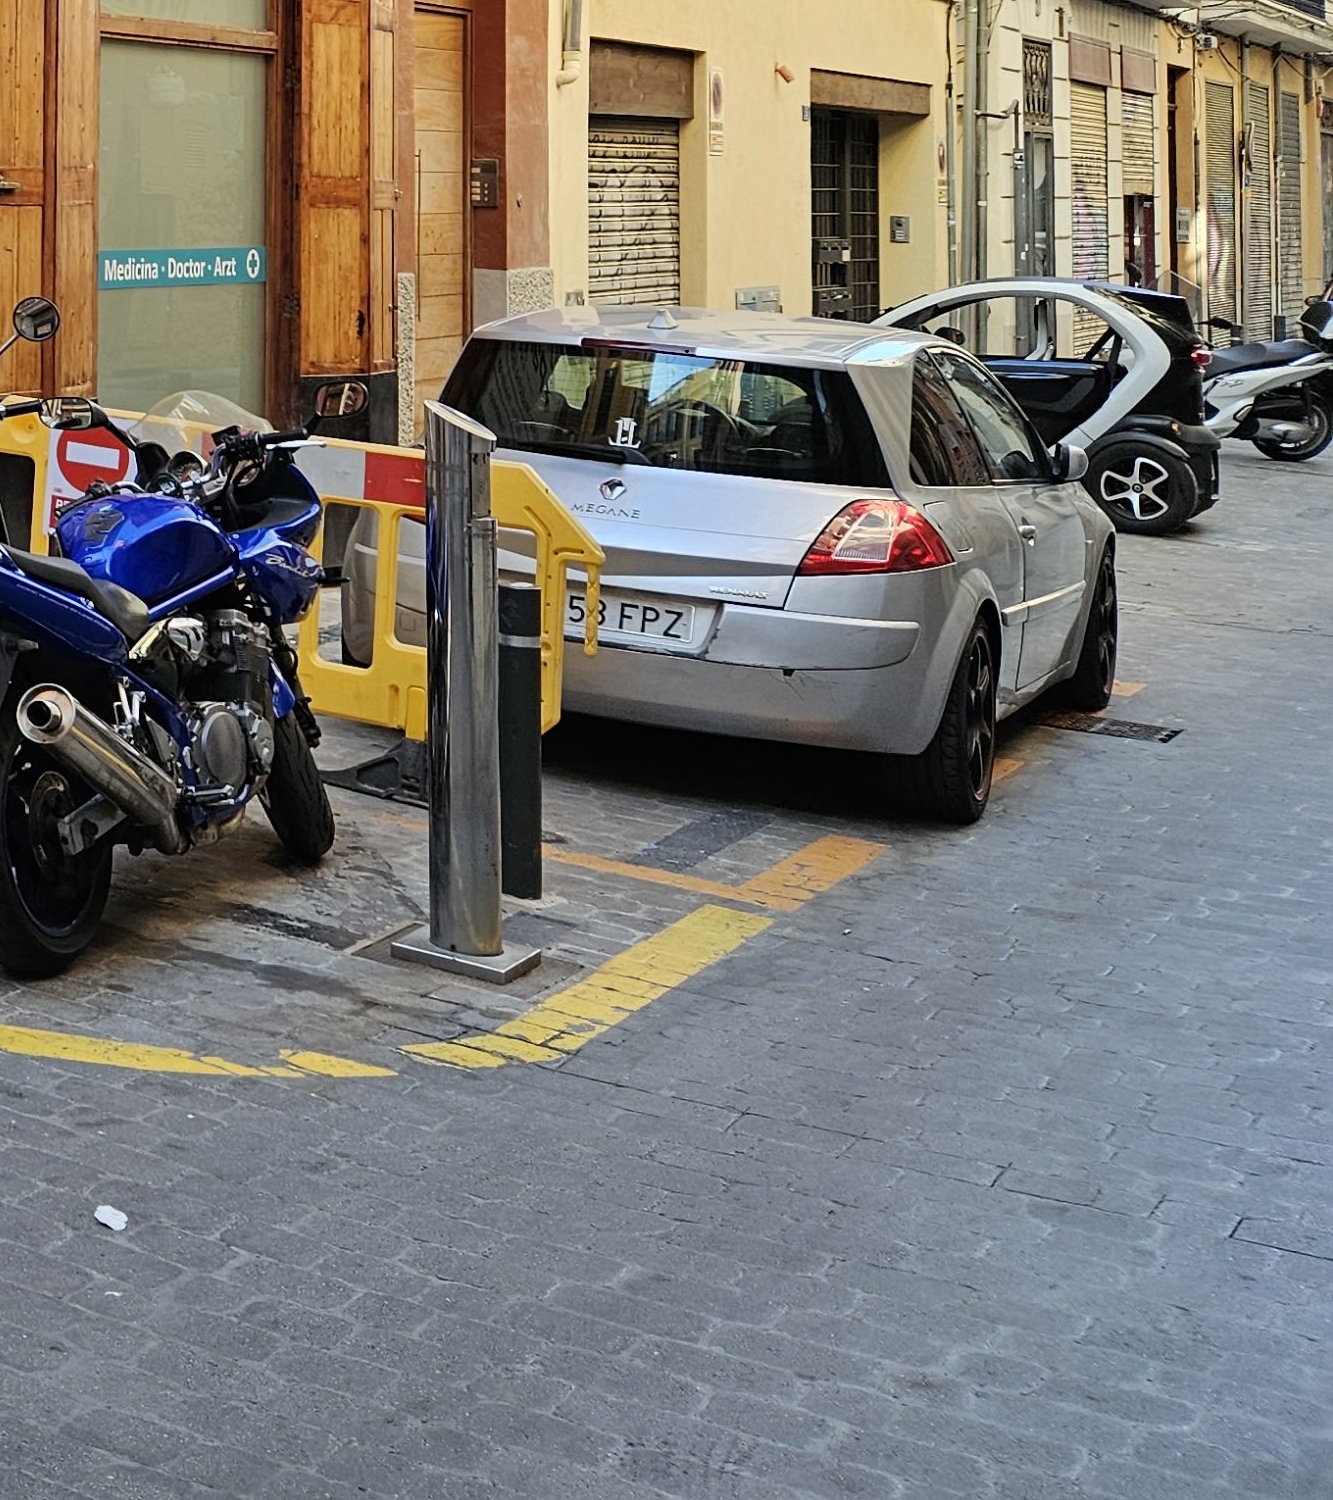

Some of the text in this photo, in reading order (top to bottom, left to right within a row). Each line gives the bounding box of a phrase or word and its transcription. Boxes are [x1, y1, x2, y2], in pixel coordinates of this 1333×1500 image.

[104, 256, 236, 282] Medicina Doctor Arzt
[571, 503, 641, 519] MEGANE
[708, 586, 770, 600] RENAULT
[618, 602, 684, 639] FPZ
